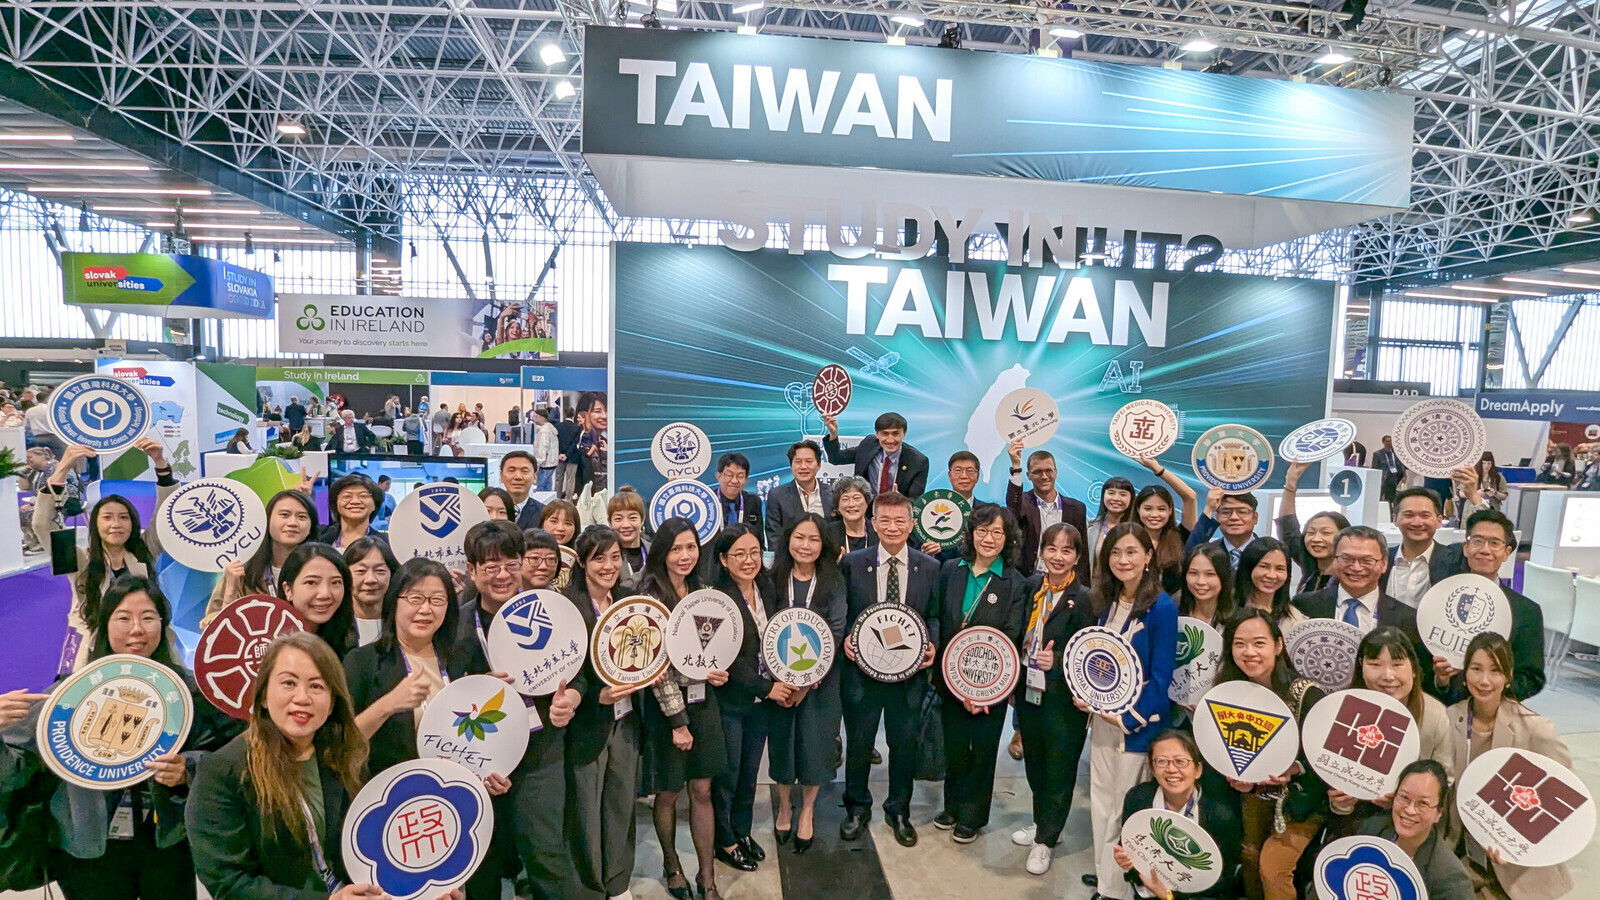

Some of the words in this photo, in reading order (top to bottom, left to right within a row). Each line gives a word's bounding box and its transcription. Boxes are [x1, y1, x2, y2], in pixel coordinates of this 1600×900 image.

[618, 58, 953, 143] TAIWAN
[718, 189, 984, 265] STUDY
[1007, 208, 1077, 270] IN
[84, 270, 117, 280] slovak
[86, 279, 145, 291] universities
[226, 270, 248, 285] STUDY
[248, 277, 257, 288] IN
[227, 282, 258, 298] SLOVAKIA
[330, 304, 425, 318] EDUCATION
[827, 264, 1170, 348] TAIWAN
[330, 319, 346, 331] IN
[351, 319, 425, 333] IRELAND
[298, 337, 313, 345] Your
[313, 338, 342, 348] journey
[352, 338, 387, 348] discovery
[114, 370, 139, 378] slovak
[284, 370, 312, 382] Study
[313, 371, 323, 380] in
[324, 371, 360, 381] Ireland
[1097, 359, 1144, 393] AI
[217, 406, 245, 423] technology
[1112, 409, 1127, 426] TAIPEI
[1126, 400, 1154, 411] MEDICAL
[1154, 402, 1176, 431] UNIVERSITY
[1480, 398, 1564, 417] DreamApply
[77, 434, 102, 448] University
[110, 434, 129, 445] Science
[1421, 452, 1442, 463] TSING
[1444, 454, 1459, 462] HUA
[1454, 419, 1469, 455] UNIVERSITY
[1199, 465, 1231, 490] PROVIDENCE
[1232, 467, 1267, 490] UNIVERSITY
[1340, 478, 1351, 498] 1
[413, 545, 466, 560] 臺北市立大
[672, 610, 686, 636] National
[684, 599, 701, 611] Taipei
[701, 595, 727, 609] University
[729, 611, 739, 643] Education
[858, 612, 868, 623] The
[876, 613, 917, 638] FICHET
[765, 620, 783, 674] MINISTRY
[781, 610, 794, 623] OF
[797, 610, 832, 663] EDUCATION
[1425, 640, 1451, 655] CATHOLIC
[1428, 626, 1472, 653] FUJE
[522, 639, 579, 686] 臺北市立大學
[600, 649, 617, 677] National
[617, 672, 640, 682] Taiwan
[682, 653, 719, 669] 北教大
[964, 646, 998, 662] SOOCHOW
[527, 670, 559, 694] UNIVERSITY
[559, 665, 567, 673] OF
[566, 654, 584, 668] TAIPEI
[784, 663, 826, 685] 教育部
[949, 662, 959, 680] UNTO
[959, 683, 974, 697] FULL
[975, 685, 1001, 697] GROWN
[999, 672, 1011, 687] MAN
[961, 667, 998, 685] UNIVERSITY
[1074, 657, 1089, 691] TUNGHAI
[1089, 679, 1129, 702] UNIVERSITY
[1175, 691, 1189, 701] Tzu
[1188, 685, 1200, 694] Chi
[52, 720, 97, 778] PROVIDENCE
[97, 744, 166, 780] UNIVERSITY
[424, 734, 492, 768] FICHET
[1314, 763, 1333, 775] National
[1333, 772, 1348, 783] Cheng
[1347, 779, 1361, 788] Kung
[1360, 784, 1381, 797] University
[1316, 753, 1386, 791] 國立成功大學
[1124, 838, 1137, 852] Tzu
[1137, 850, 1148, 862] Chi
[1148, 860, 1182, 891] University
